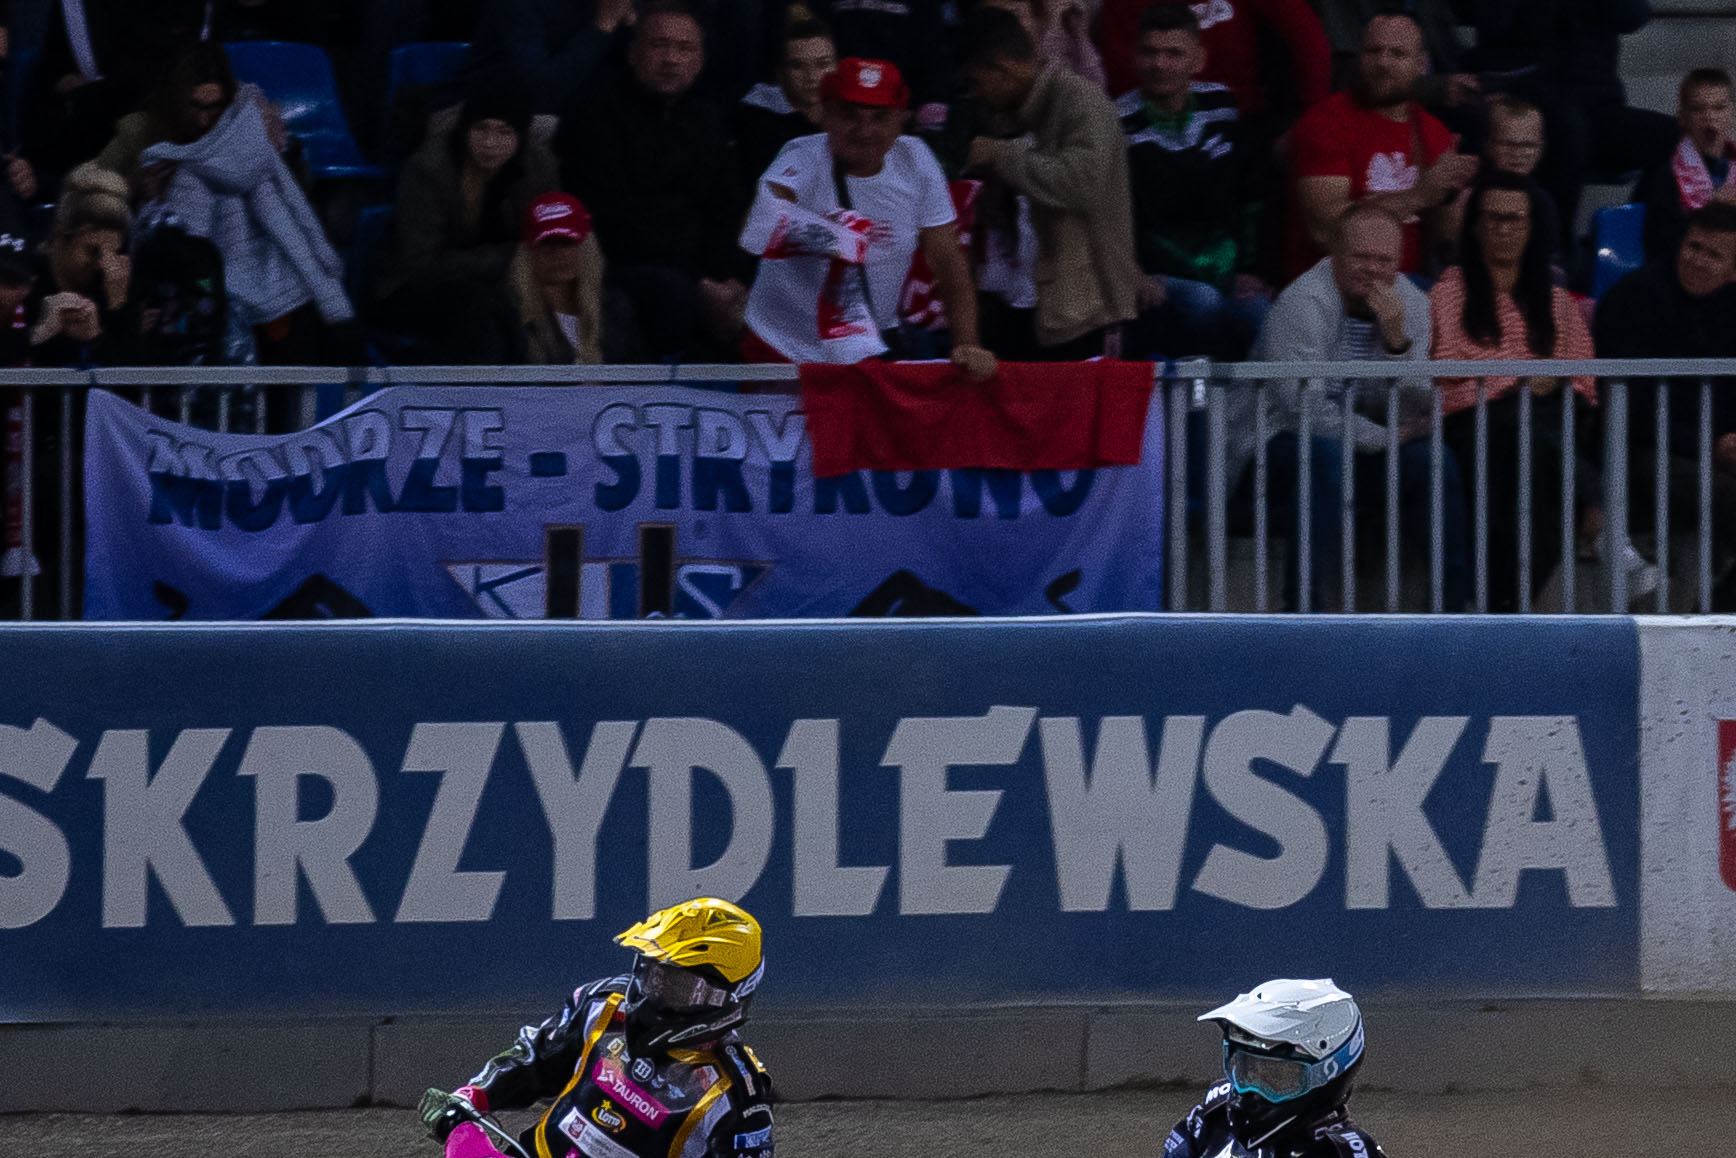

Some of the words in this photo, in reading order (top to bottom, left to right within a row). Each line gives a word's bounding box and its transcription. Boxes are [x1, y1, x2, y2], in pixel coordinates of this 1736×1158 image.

[0, 704, 1618, 929] SKRZYDLEWSKA
[612, 1079, 659, 1121] TAURON
[1205, 1082, 1230, 1105] MO
[597, 1109, 622, 1127] LOTTO
